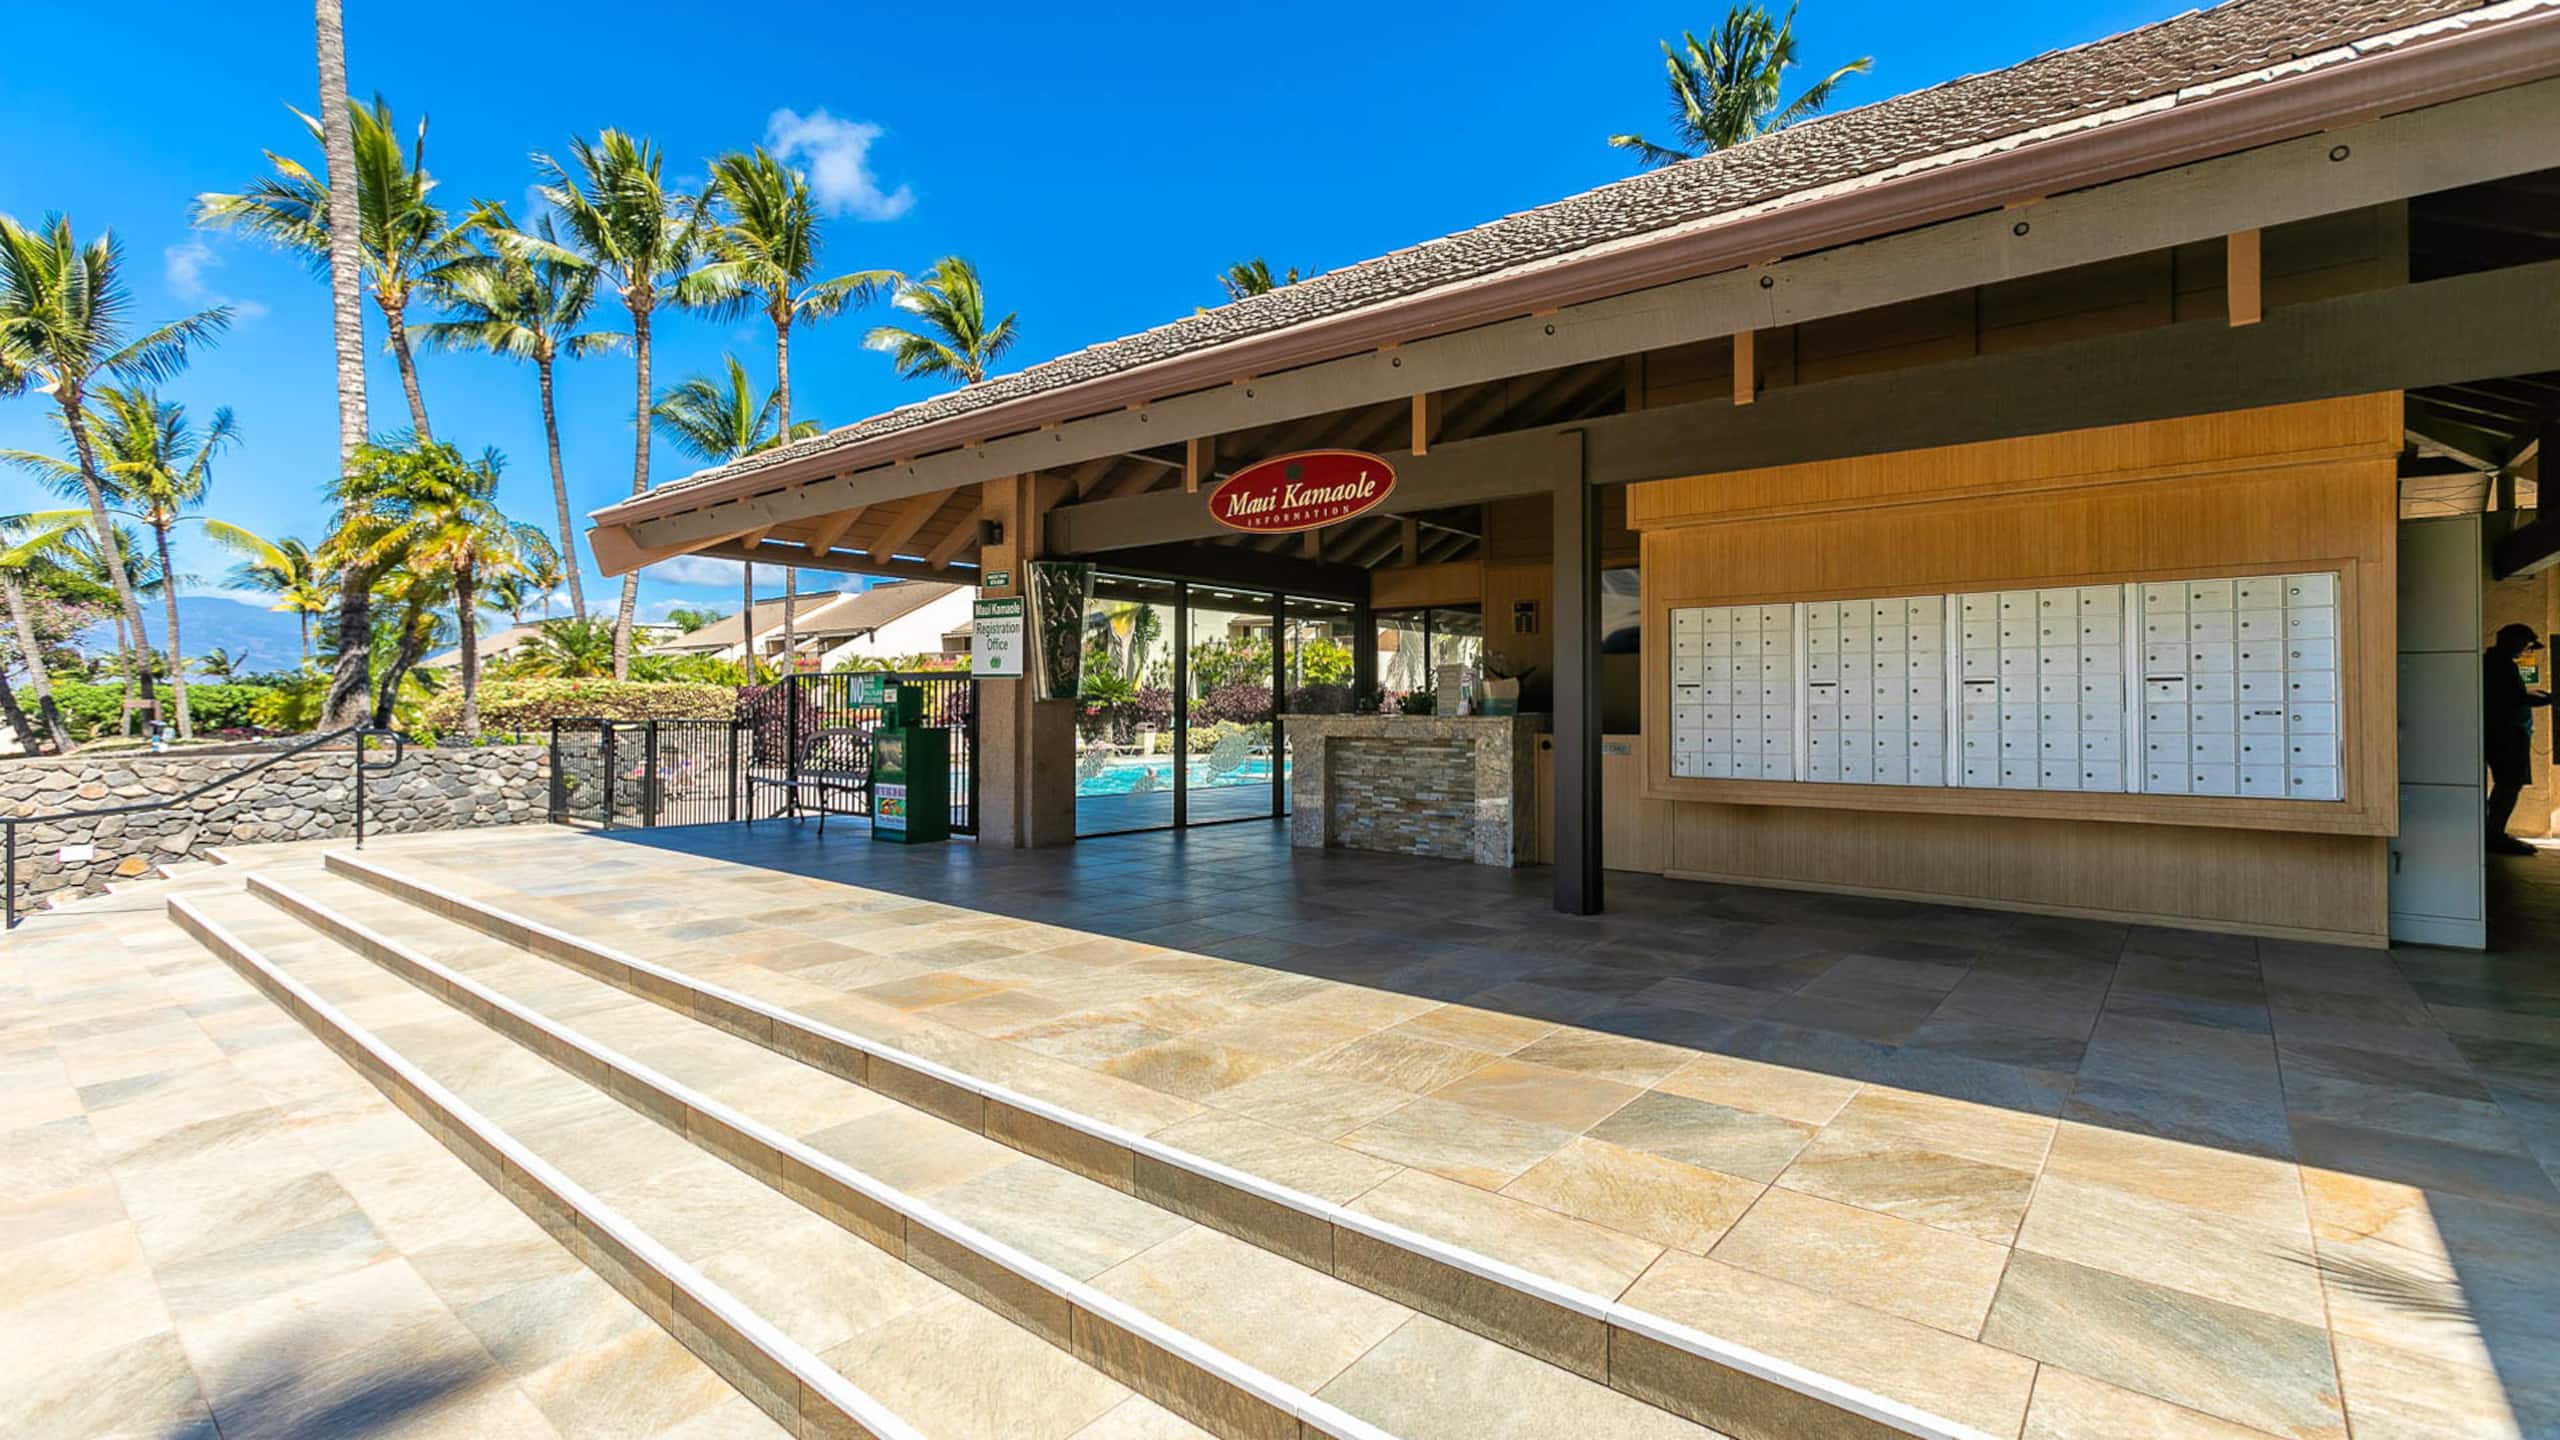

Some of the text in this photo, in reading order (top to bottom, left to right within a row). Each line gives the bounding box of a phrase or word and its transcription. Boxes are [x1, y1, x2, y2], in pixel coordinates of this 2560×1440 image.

[1226, 471, 1376, 518] Maui Kamaole
[1247, 505, 1351, 528] INFORMATION
[992, 602, 1020, 615] Kamaole
[976, 622, 1020, 638] Registration
[987, 638, 1009, 650] Office
[850, 676, 864, 704] NO
